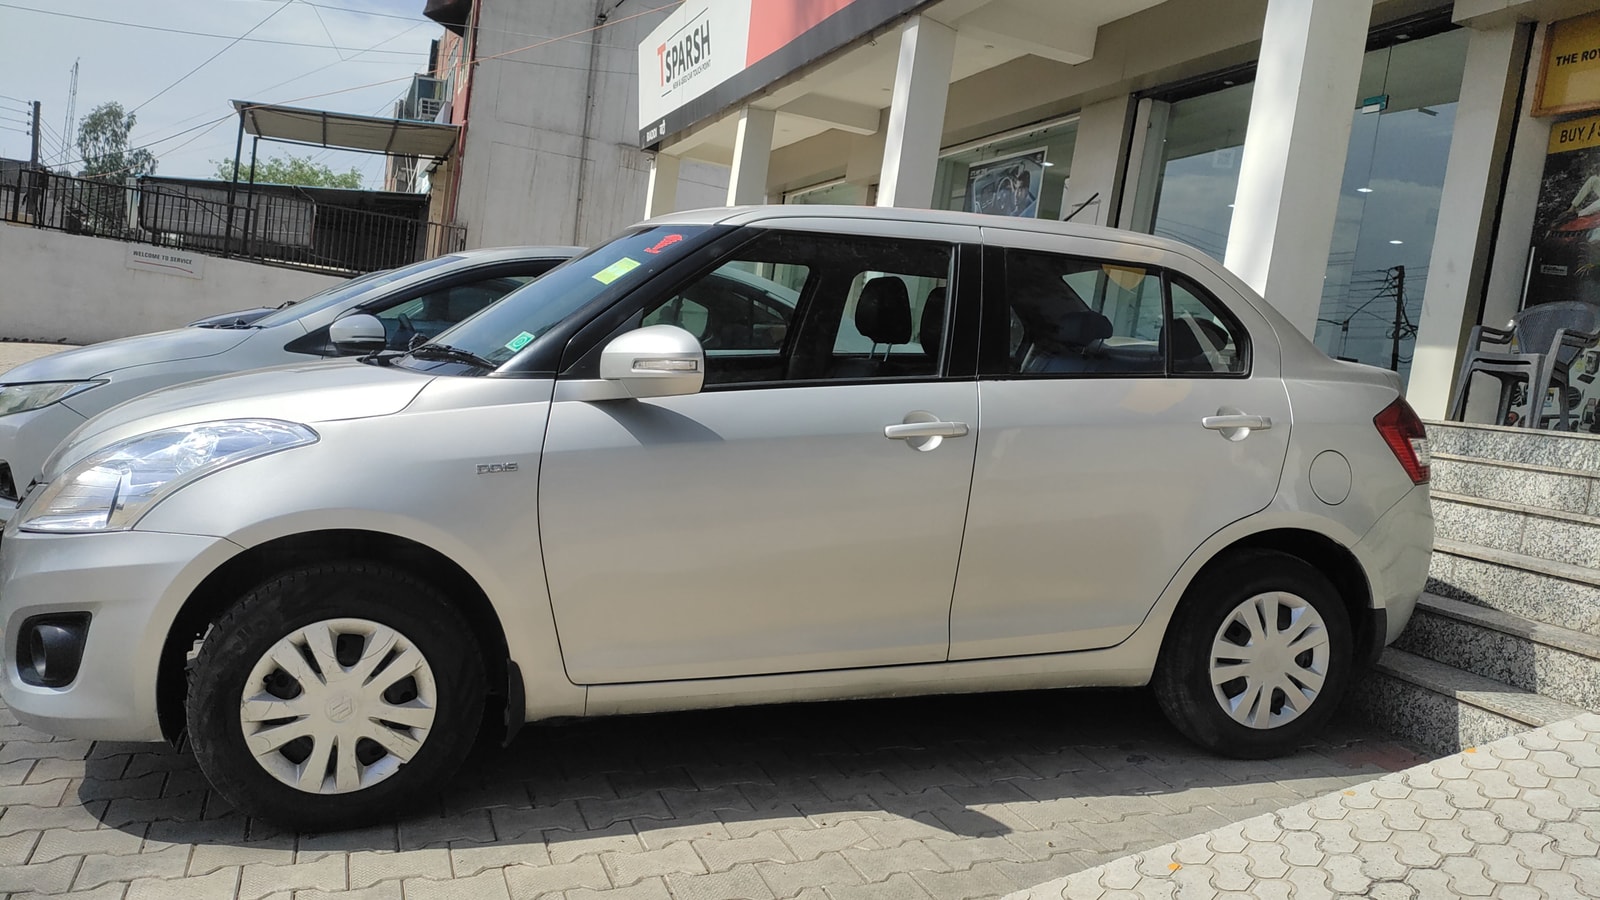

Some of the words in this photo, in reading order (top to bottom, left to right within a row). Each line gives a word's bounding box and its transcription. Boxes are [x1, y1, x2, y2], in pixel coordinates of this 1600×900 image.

[702, 59, 711, 70] POINT
[1556, 53, 1578, 66] THE
[1560, 126, 1586, 143] BUY
[133, 250, 160, 260] WELCOME
[170, 256, 193, 265] SERVICE
